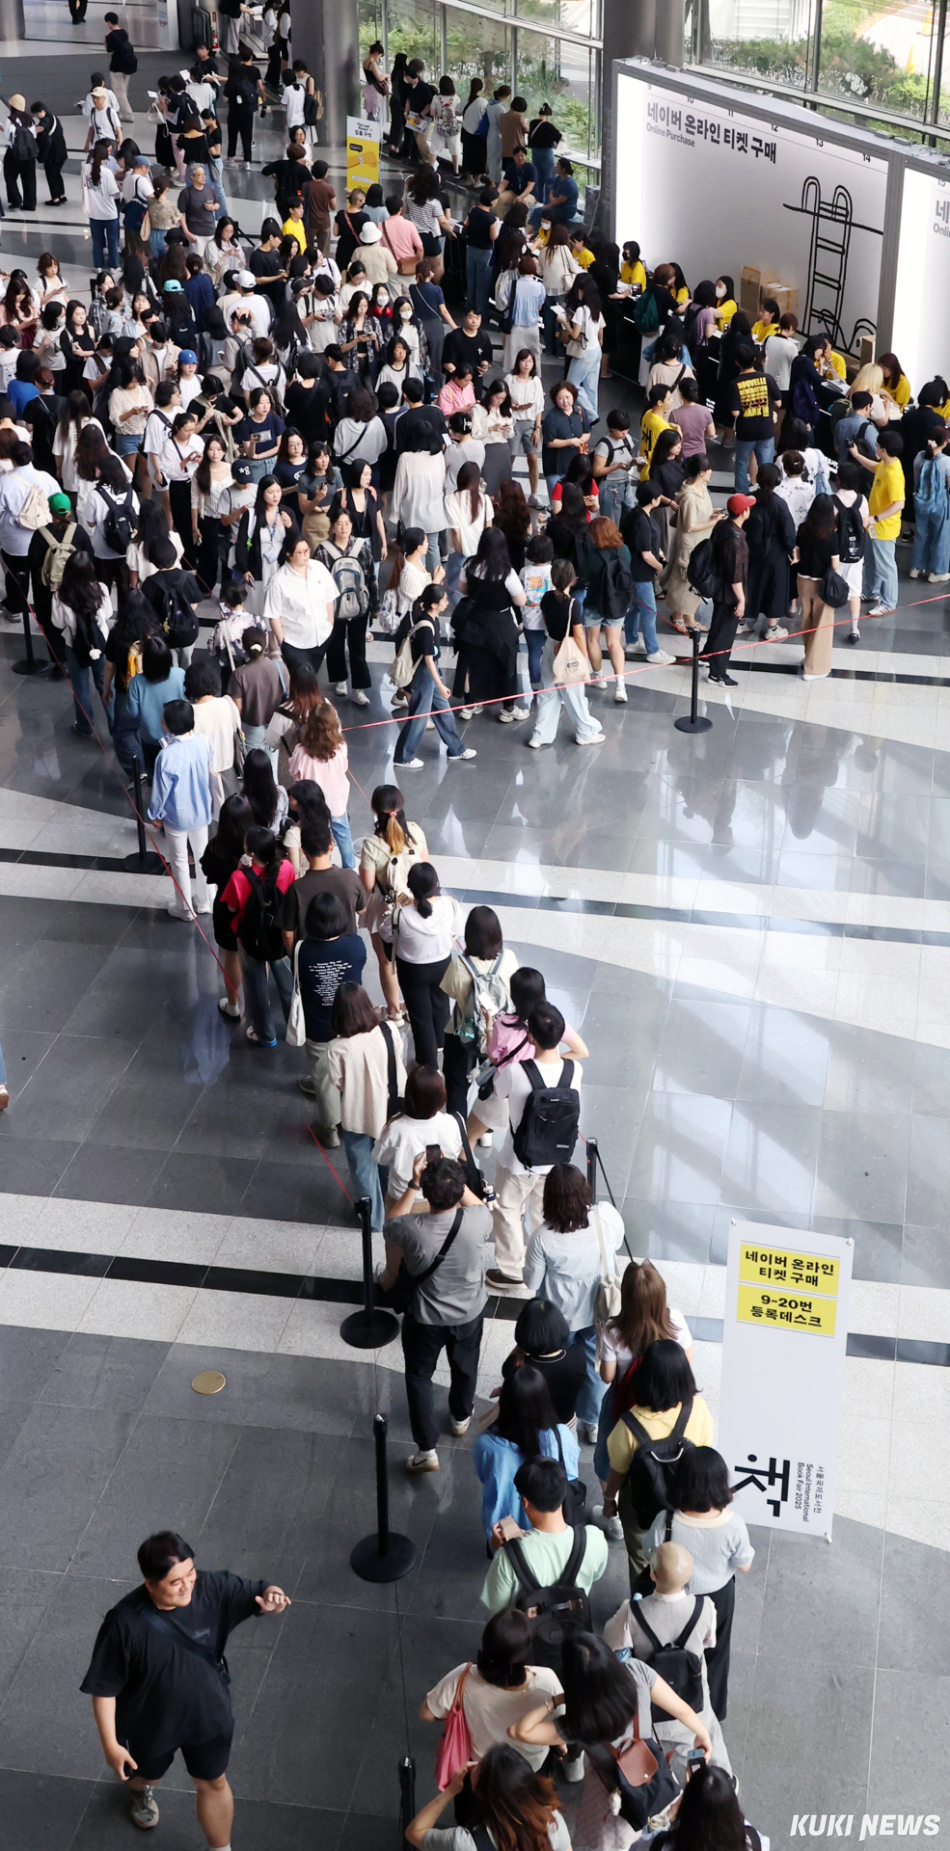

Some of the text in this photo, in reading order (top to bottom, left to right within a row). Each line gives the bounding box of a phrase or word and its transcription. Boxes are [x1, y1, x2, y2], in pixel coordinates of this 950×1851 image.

[646, 122, 696, 147] Online Purchase
[647, 102, 777, 164] 네이버 온라인 티켓 구매
[816, 138, 824, 147] 13
[863, 153, 871, 163] 14
[737, 376, 767, 389] NOUVELLE
[745, 1251, 834, 1276] 네이버 온라인
[759, 1267, 818, 1287] 티켓 구매
[761, 1294, 812, 1313] 9~20번
[750, 1306, 822, 1327] 등록데스크
[794, 1462, 805, 1510] Book Fair 2025
[803, 1463, 814, 1522] Seoul International
[813, 1465, 825, 1514] 서울국제도서전
